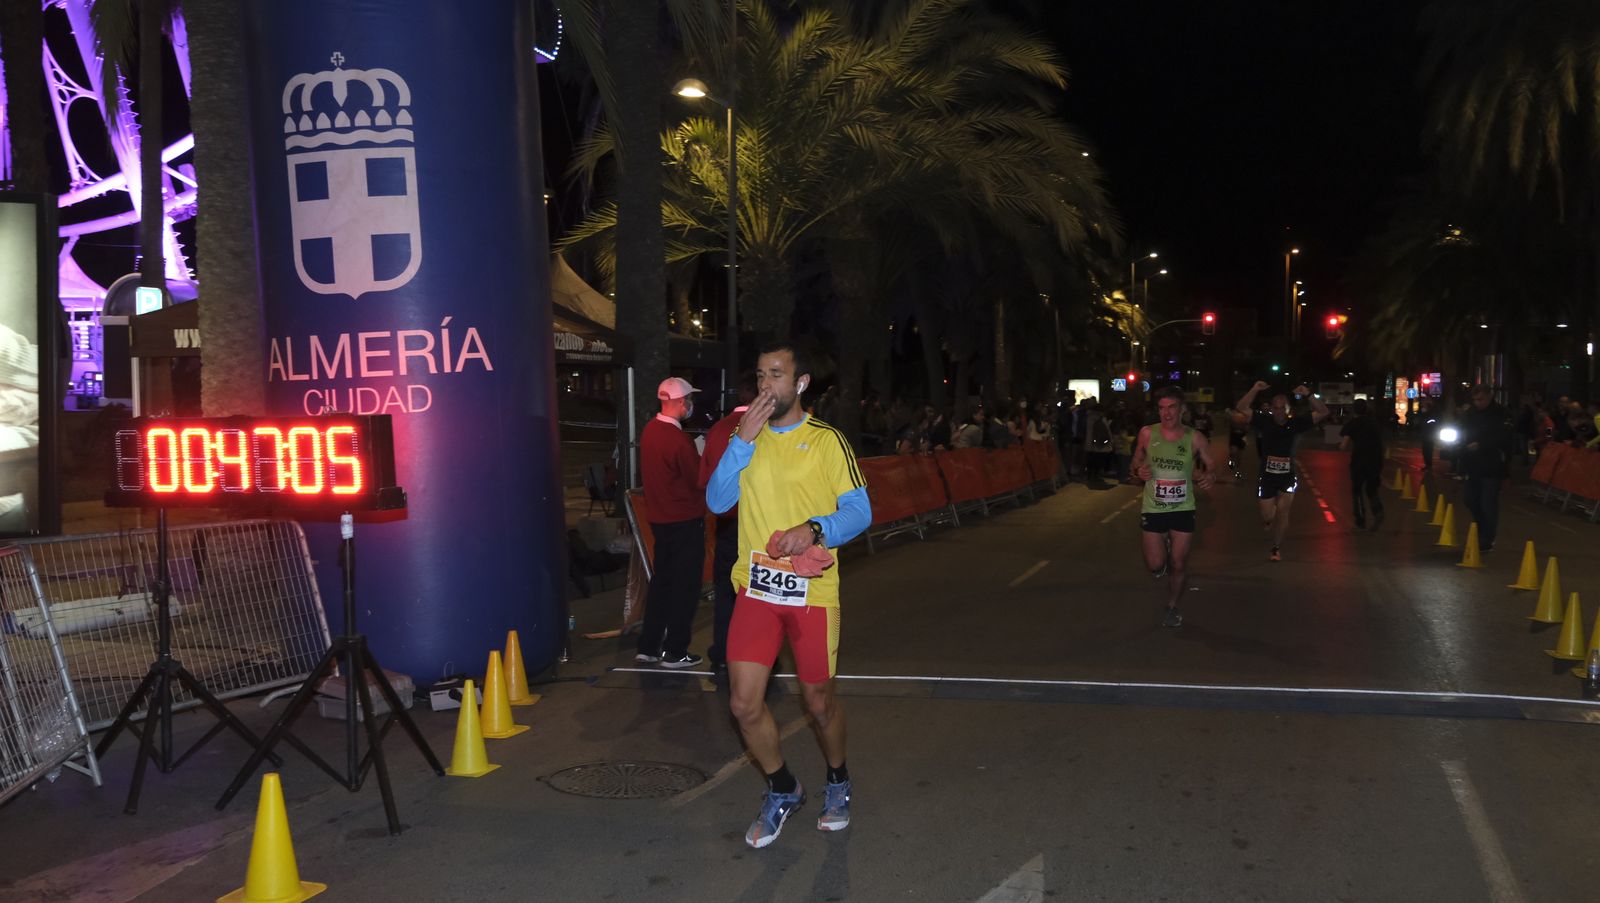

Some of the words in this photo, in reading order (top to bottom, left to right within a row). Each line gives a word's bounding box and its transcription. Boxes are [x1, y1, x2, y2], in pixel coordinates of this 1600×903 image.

[268, 316, 494, 382] ALMERÍA
[303, 384, 433, 416] CIUDAD
[147, 426, 361, 494] 00:47:05
[1161, 486, 1182, 495] 146
[760, 568, 798, 590] 246
